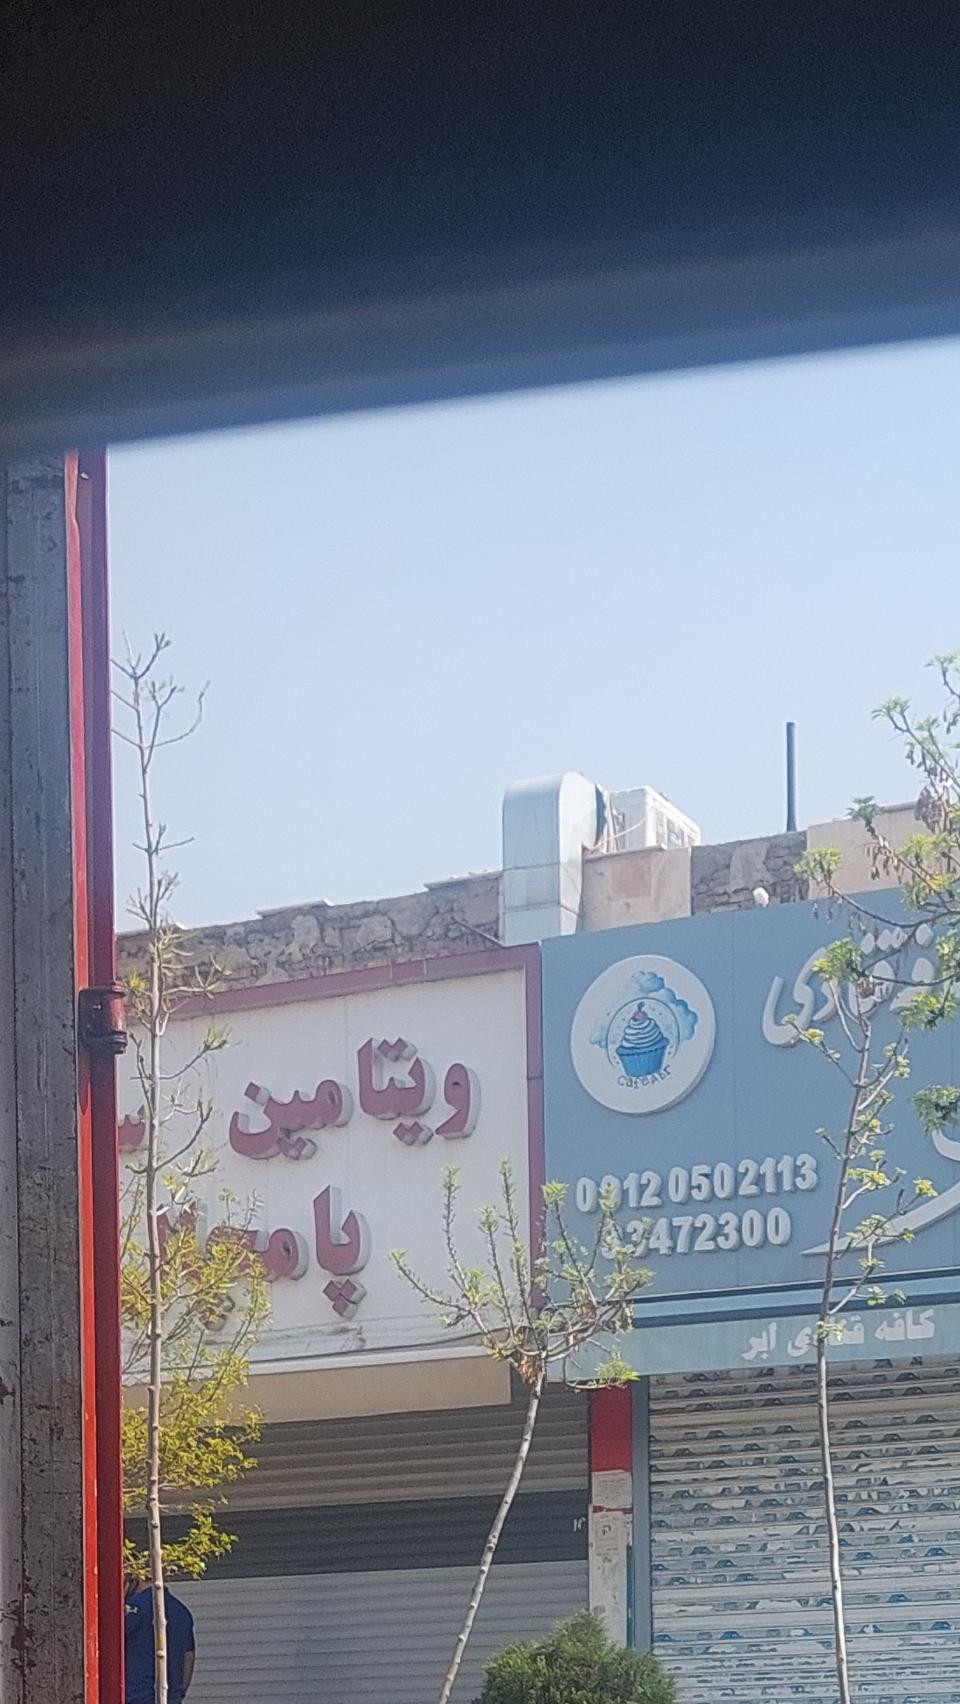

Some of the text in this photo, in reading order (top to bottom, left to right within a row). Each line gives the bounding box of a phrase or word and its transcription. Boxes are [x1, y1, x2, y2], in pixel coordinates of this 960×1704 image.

[763, 928, 905, 1047] قندی
[229, 1036, 481, 1160] ویتامین
[576, 1173, 663, 1214] 0912
[741, 1322, 777, 1361] ابر
[874, 1308, 935, 1342] کافه
